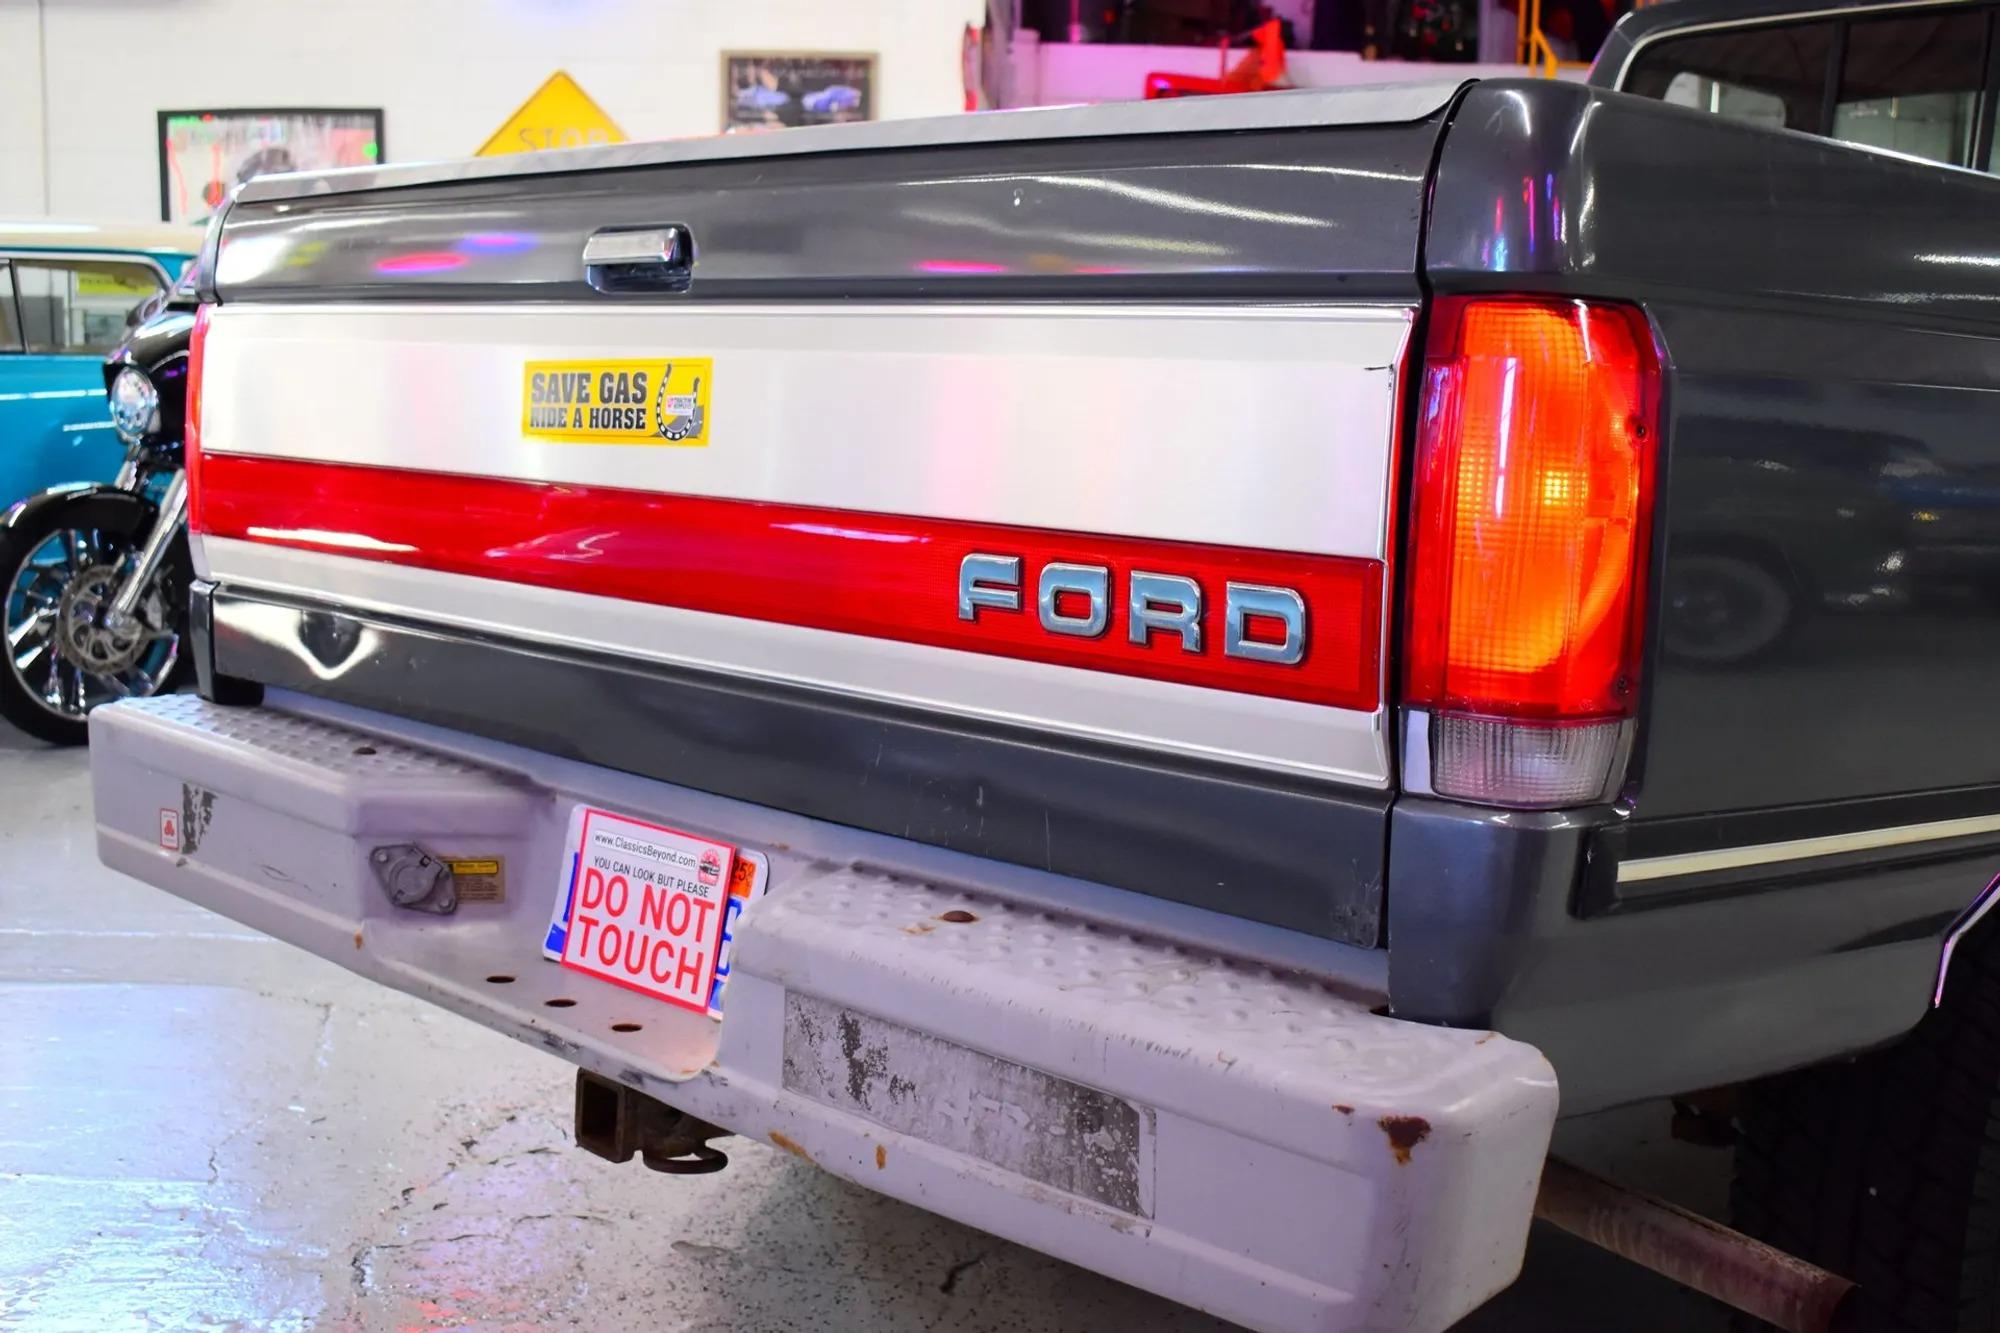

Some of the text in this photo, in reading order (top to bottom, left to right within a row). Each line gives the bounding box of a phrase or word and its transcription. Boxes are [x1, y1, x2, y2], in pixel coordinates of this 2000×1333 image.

[531, 372, 591, 403] SAVE
[599, 372, 647, 404] GAS
[530, 407, 646, 429] RIDE A HORSE
[958, 553, 1306, 665] FORD
[595, 834, 696, 868] www.ClassicsBeyond.com
[594, 856, 710, 898] YOU CAN LOOK BUT PLEASE
[581, 867, 629, 917] DO
[639, 883, 715, 943] NOT
[578, 915, 704, 995] TOUCH
